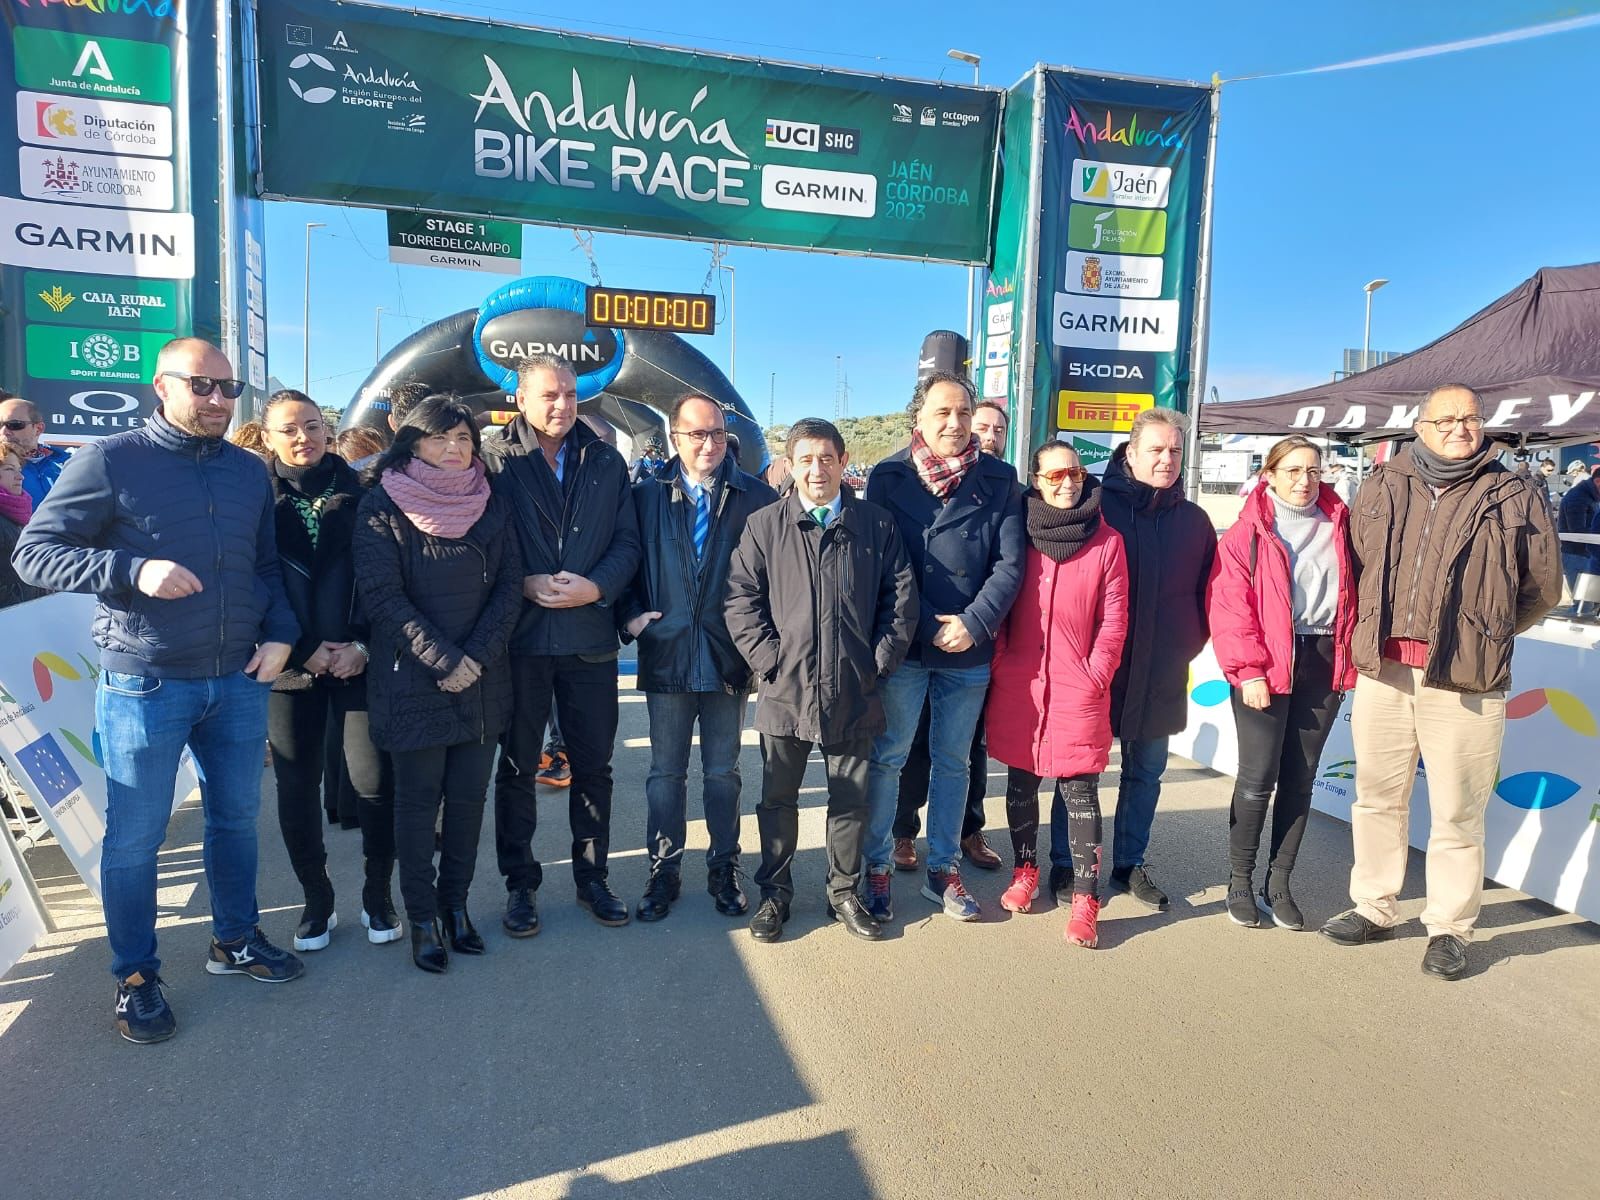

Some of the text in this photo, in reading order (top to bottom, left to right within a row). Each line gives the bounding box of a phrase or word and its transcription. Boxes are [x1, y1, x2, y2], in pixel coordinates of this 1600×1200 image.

[49, 77, 141, 96] Junta de Andalucía
[342, 63, 422, 92] Andalucía
[342, 87, 371, 97] Región
[373, 91, 407, 101] Europea
[342, 96, 393, 109] DEPORTE
[469, 54, 750, 159] Andalucía
[84, 115, 155, 132] Diputación
[942, 112, 980, 126] octagon
[1063, 105, 1184, 149] Andalucía
[84, 129, 156, 145] de Córdoba
[775, 125, 816, 146] UCI
[824, 132, 854, 150] SHC
[82, 165, 156, 182] AYUNTAMIENTO
[474, 128, 751, 206] BIKE RACE
[753, 163, 762, 171] BY
[887, 158, 933, 182] JAÉN
[82, 181, 93, 192] DE
[1113, 170, 1157, 194] Jaén
[775, 180, 865, 203] GARMIN
[886, 180, 970, 206] CÓRDOBA
[886, 201, 927, 221] 2023
[426, 218, 486, 236] STAGE 1
[15, 222, 176, 257] GARMIN
[398, 232, 511, 255] TORREDELCAMPO
[430, 254, 481, 267] GARMIN
[1104, 276, 1149, 284] AYUNTAMIENTO
[82, 292, 166, 308] CAJA RURAL
[108, 306, 141, 318] JAÉN
[1059, 311, 1161, 334] GARMIN
[490, 340, 600, 361] GARMIN
[70, 369, 141, 379] SPORT BEARINGS
[1288, 391, 1597, 429] OAKEY
[1313, 779, 1347, 797] con Europa
